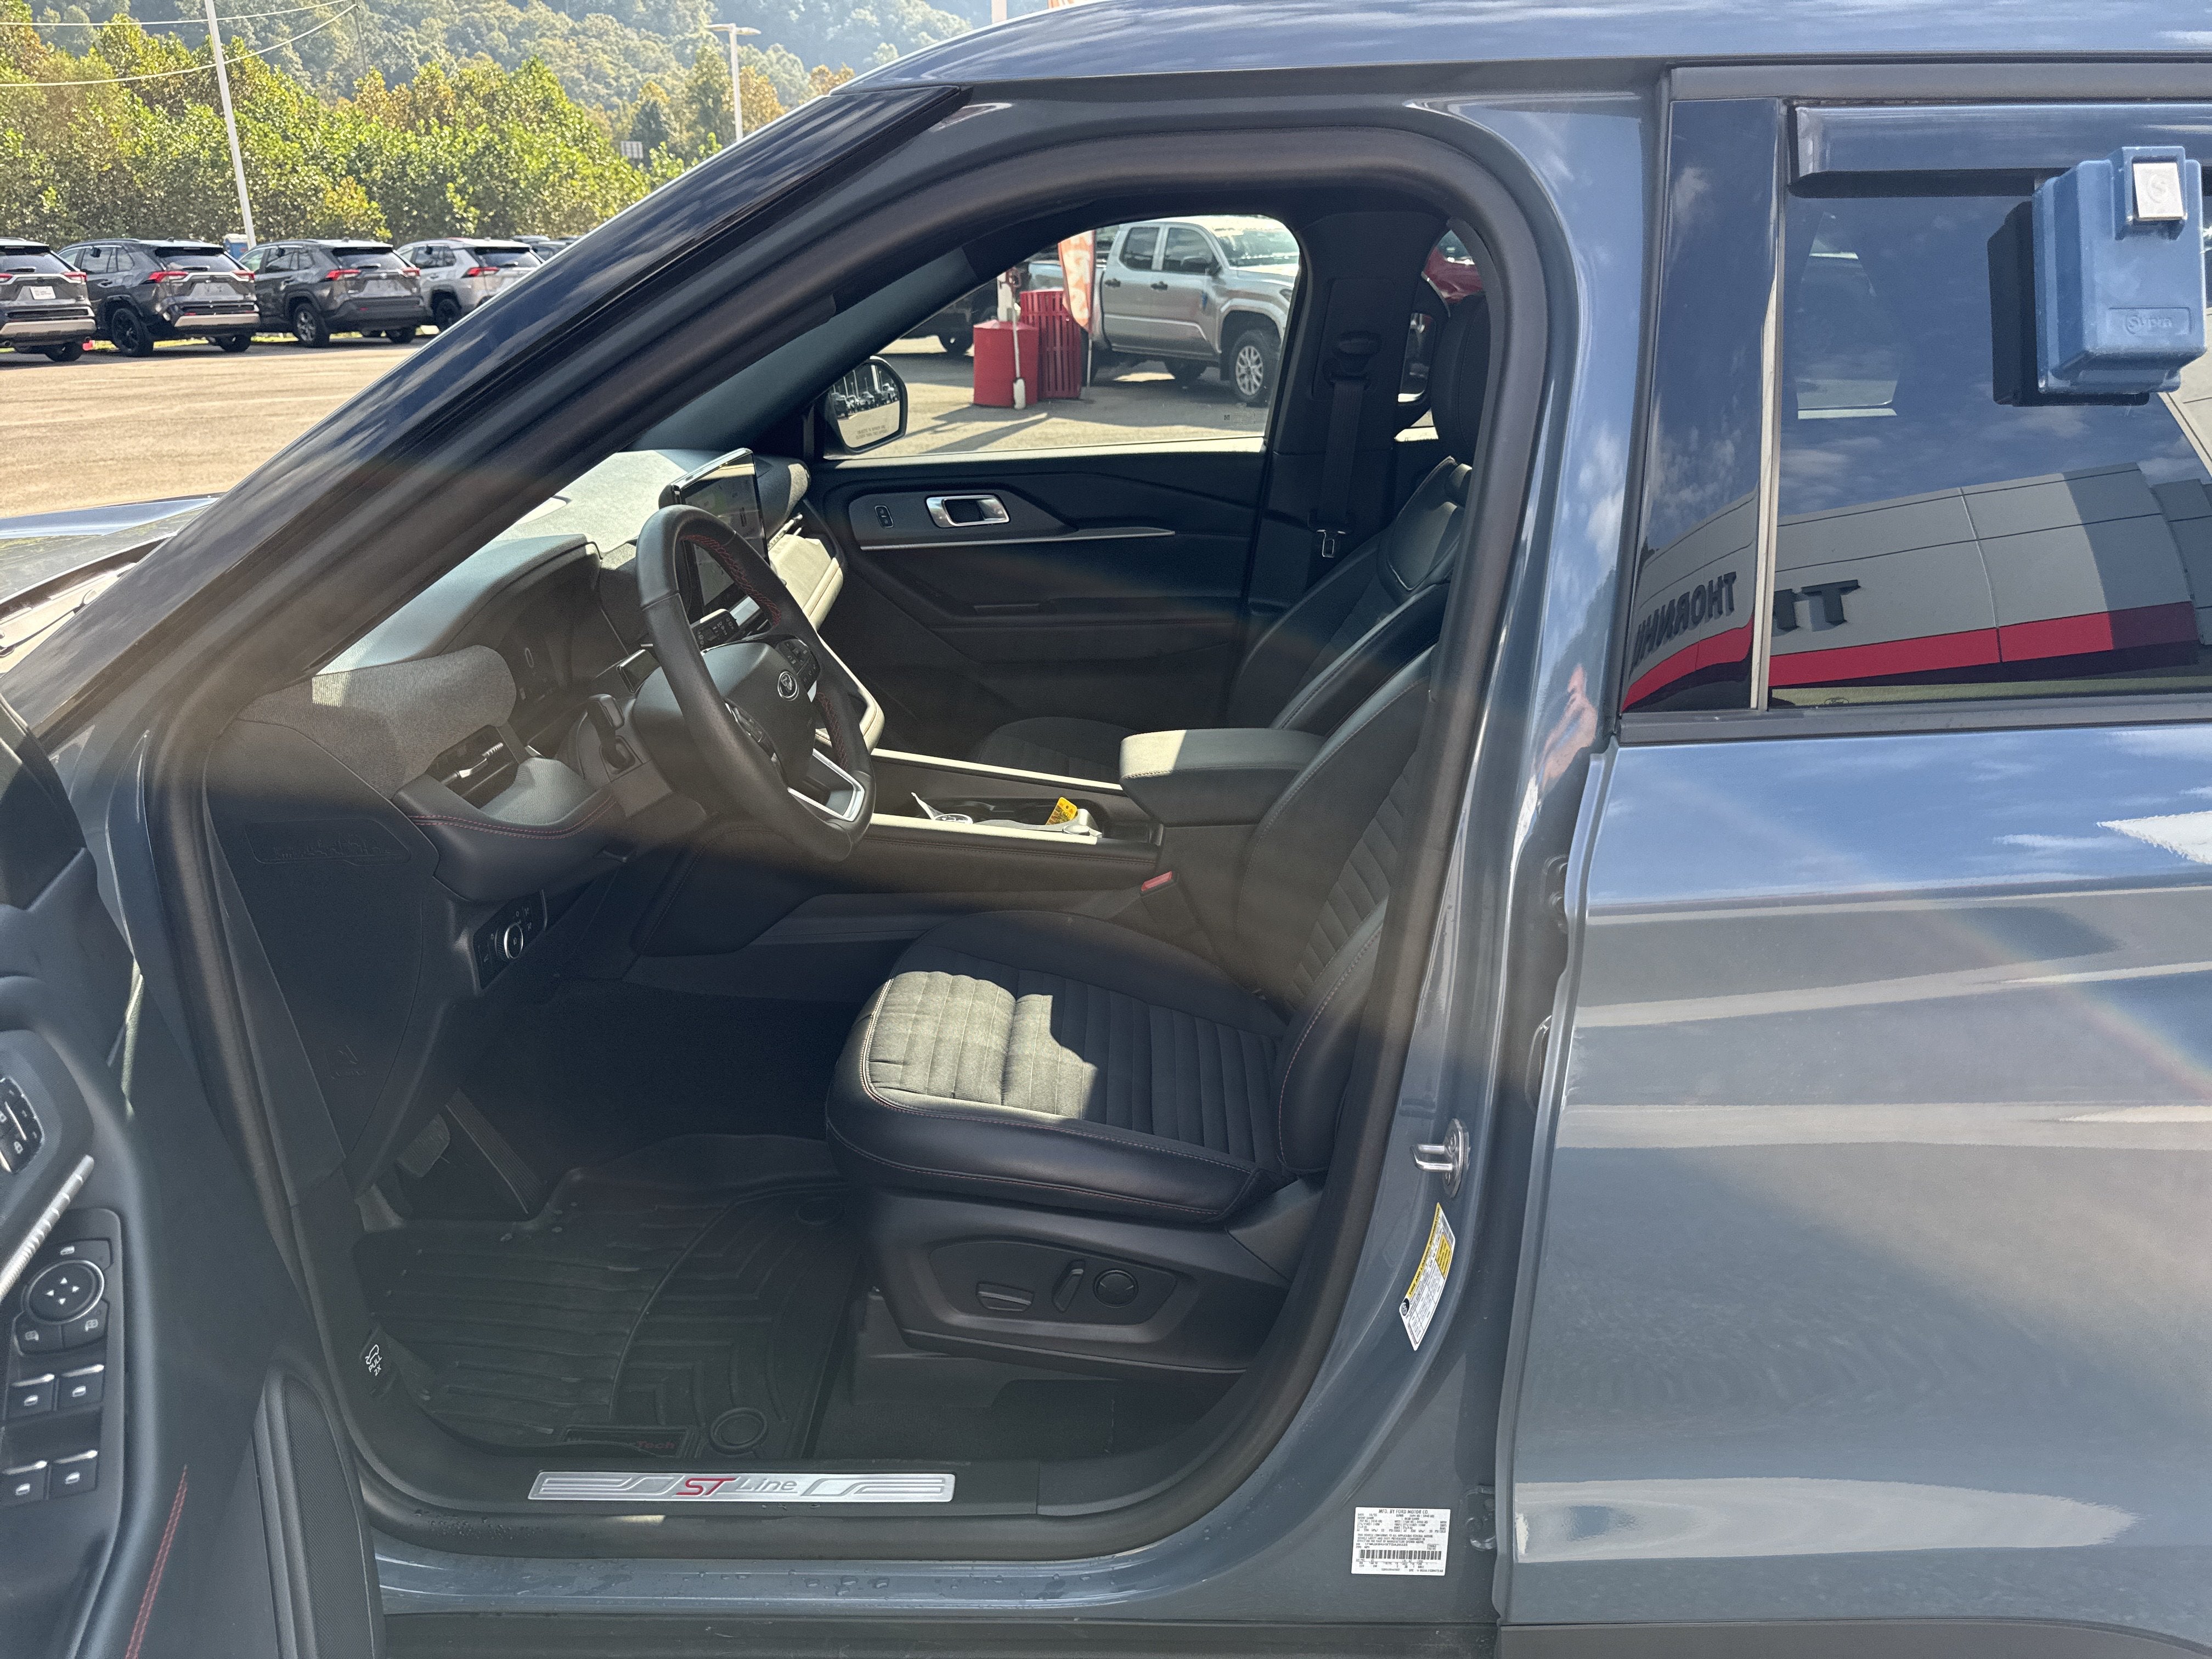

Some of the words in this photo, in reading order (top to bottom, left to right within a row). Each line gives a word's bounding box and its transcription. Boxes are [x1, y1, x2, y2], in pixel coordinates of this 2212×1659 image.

[368, 1355, 382, 1373] PULL
[374, 1364, 382, 1376] 2X
[675, 1477, 737, 1496] ST
[736, 1479, 798, 1492] Line
